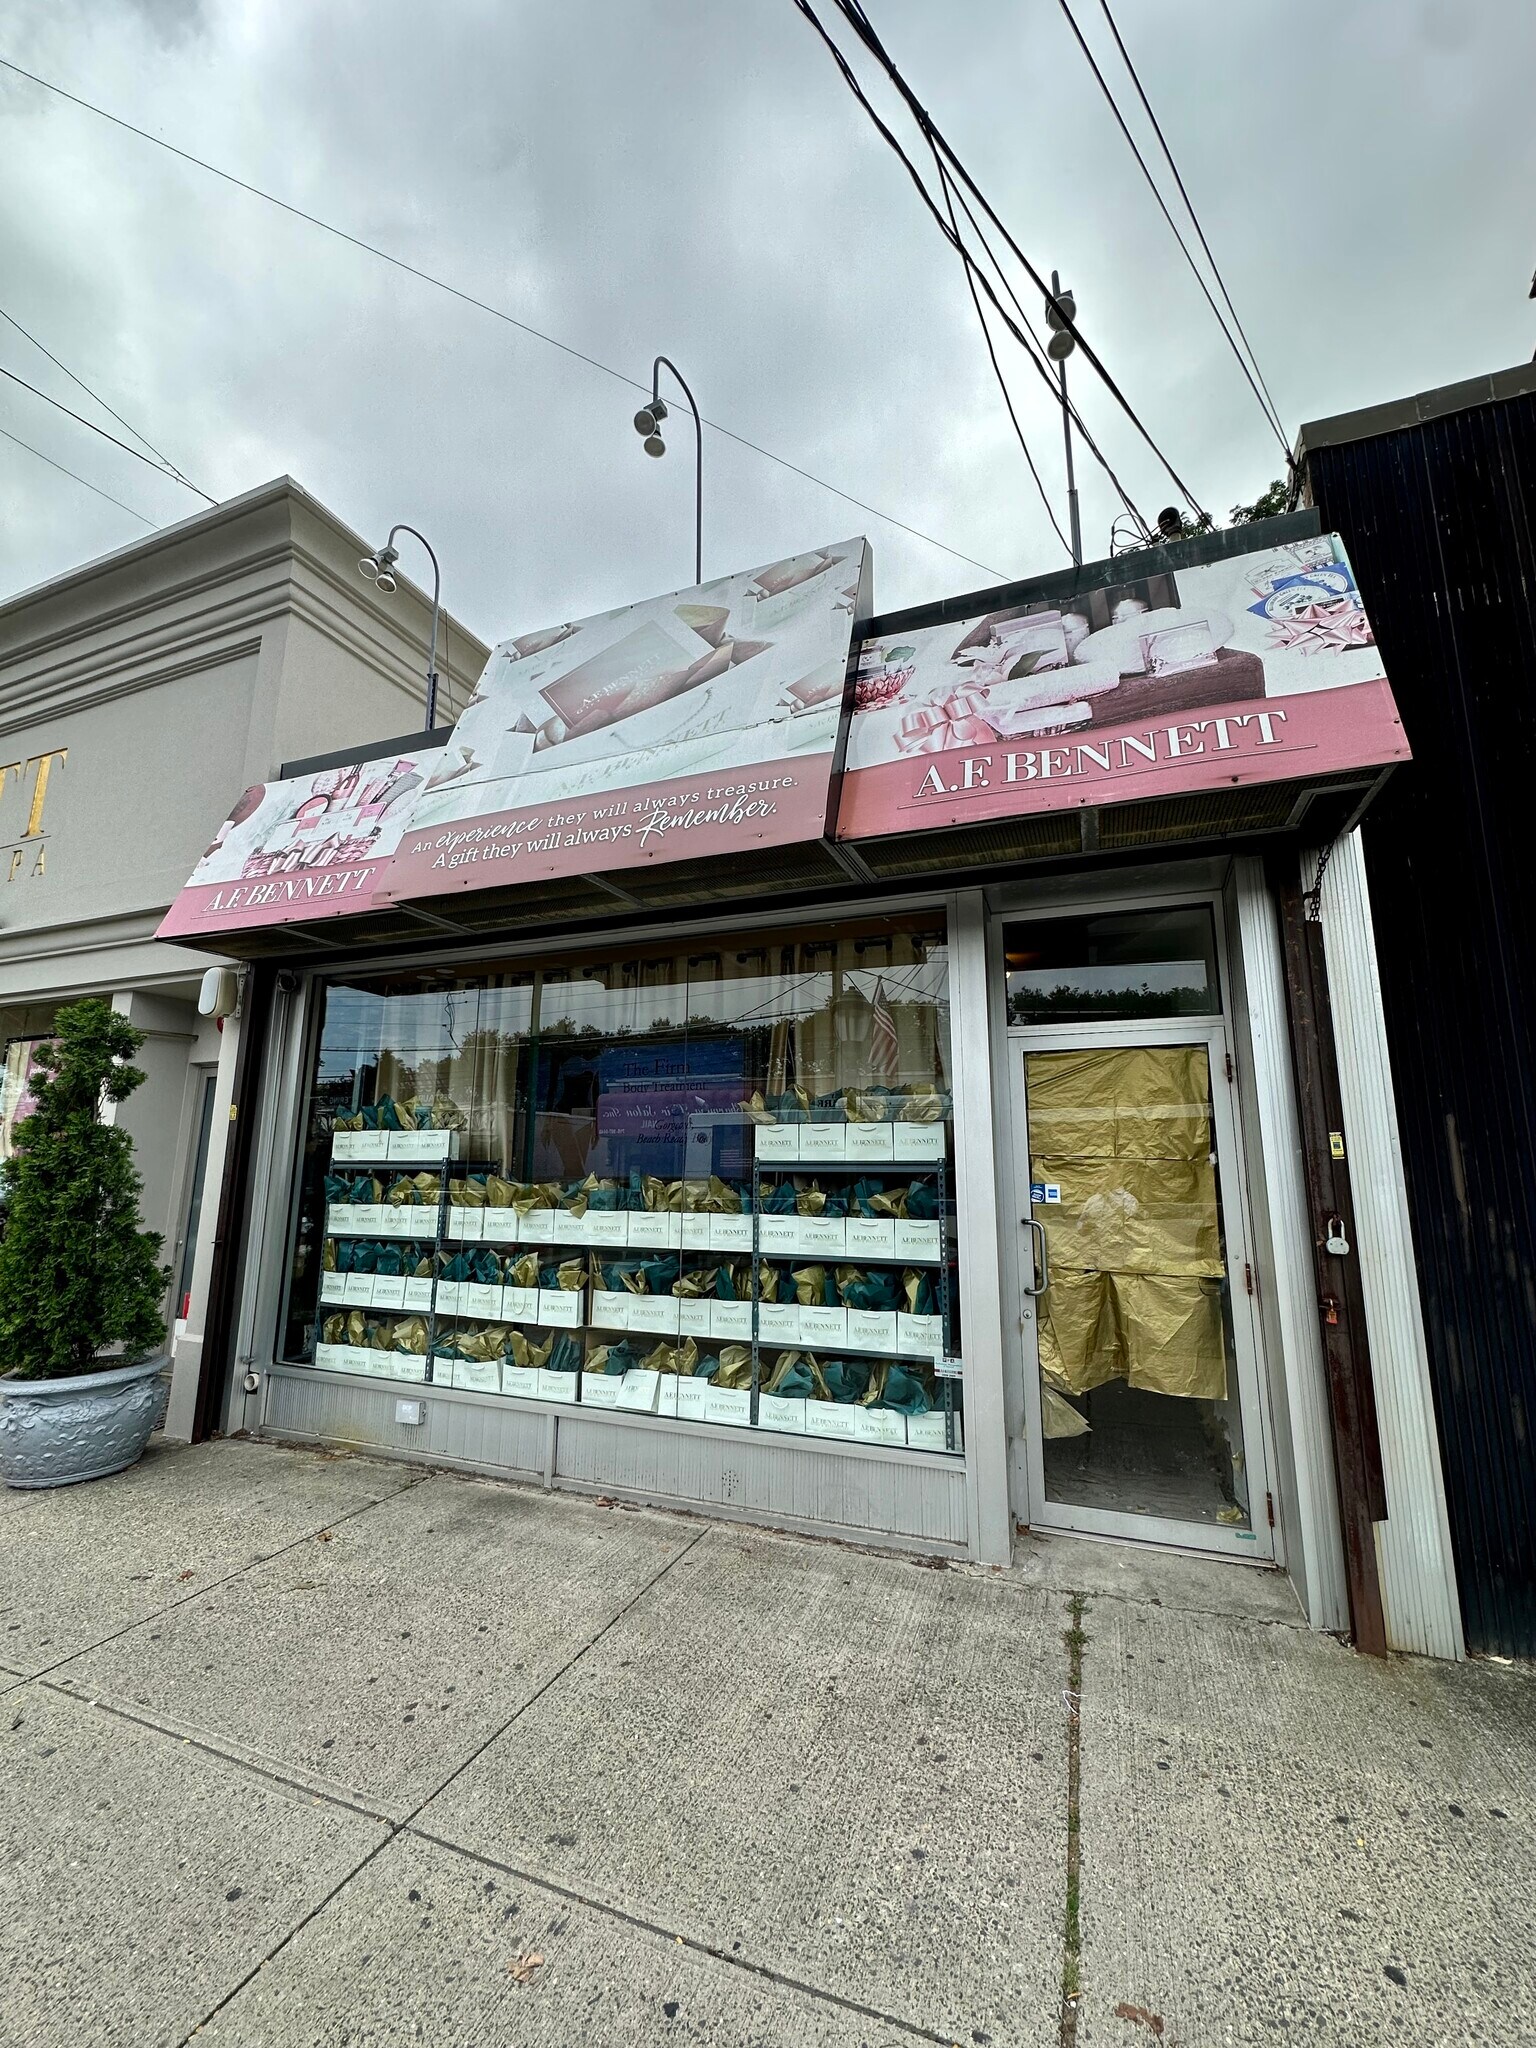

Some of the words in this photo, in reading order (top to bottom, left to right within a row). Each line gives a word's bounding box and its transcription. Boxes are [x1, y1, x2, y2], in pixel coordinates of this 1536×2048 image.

[912, 756, 990, 798] A.F.
[1000, 709, 1289, 784] BENNETT
[410, 841, 432, 854] An
[435, 816, 544, 853] experience
[548, 810, 587, 829] they
[592, 801, 628, 821] will
[632, 791, 701, 814] always
[707, 775, 799, 801] treasure.
[431, 852, 446, 869] A
[448, 847, 479, 869] gift
[482, 841, 523, 861] they
[526, 832, 562, 853] will
[563, 822, 633, 848] always
[635, 793, 777, 848] Remember.
[202, 885, 249, 914] A.F.
[244, 866, 377, 907] BENNETT
[623, 1061, 649, 1079] The
[653, 1057, 691, 1077] Firm
[623, 1081, 650, 1094] Body
[652, 1080, 706, 1092] Treatment
[636, 1132, 661, 1144] Beach
